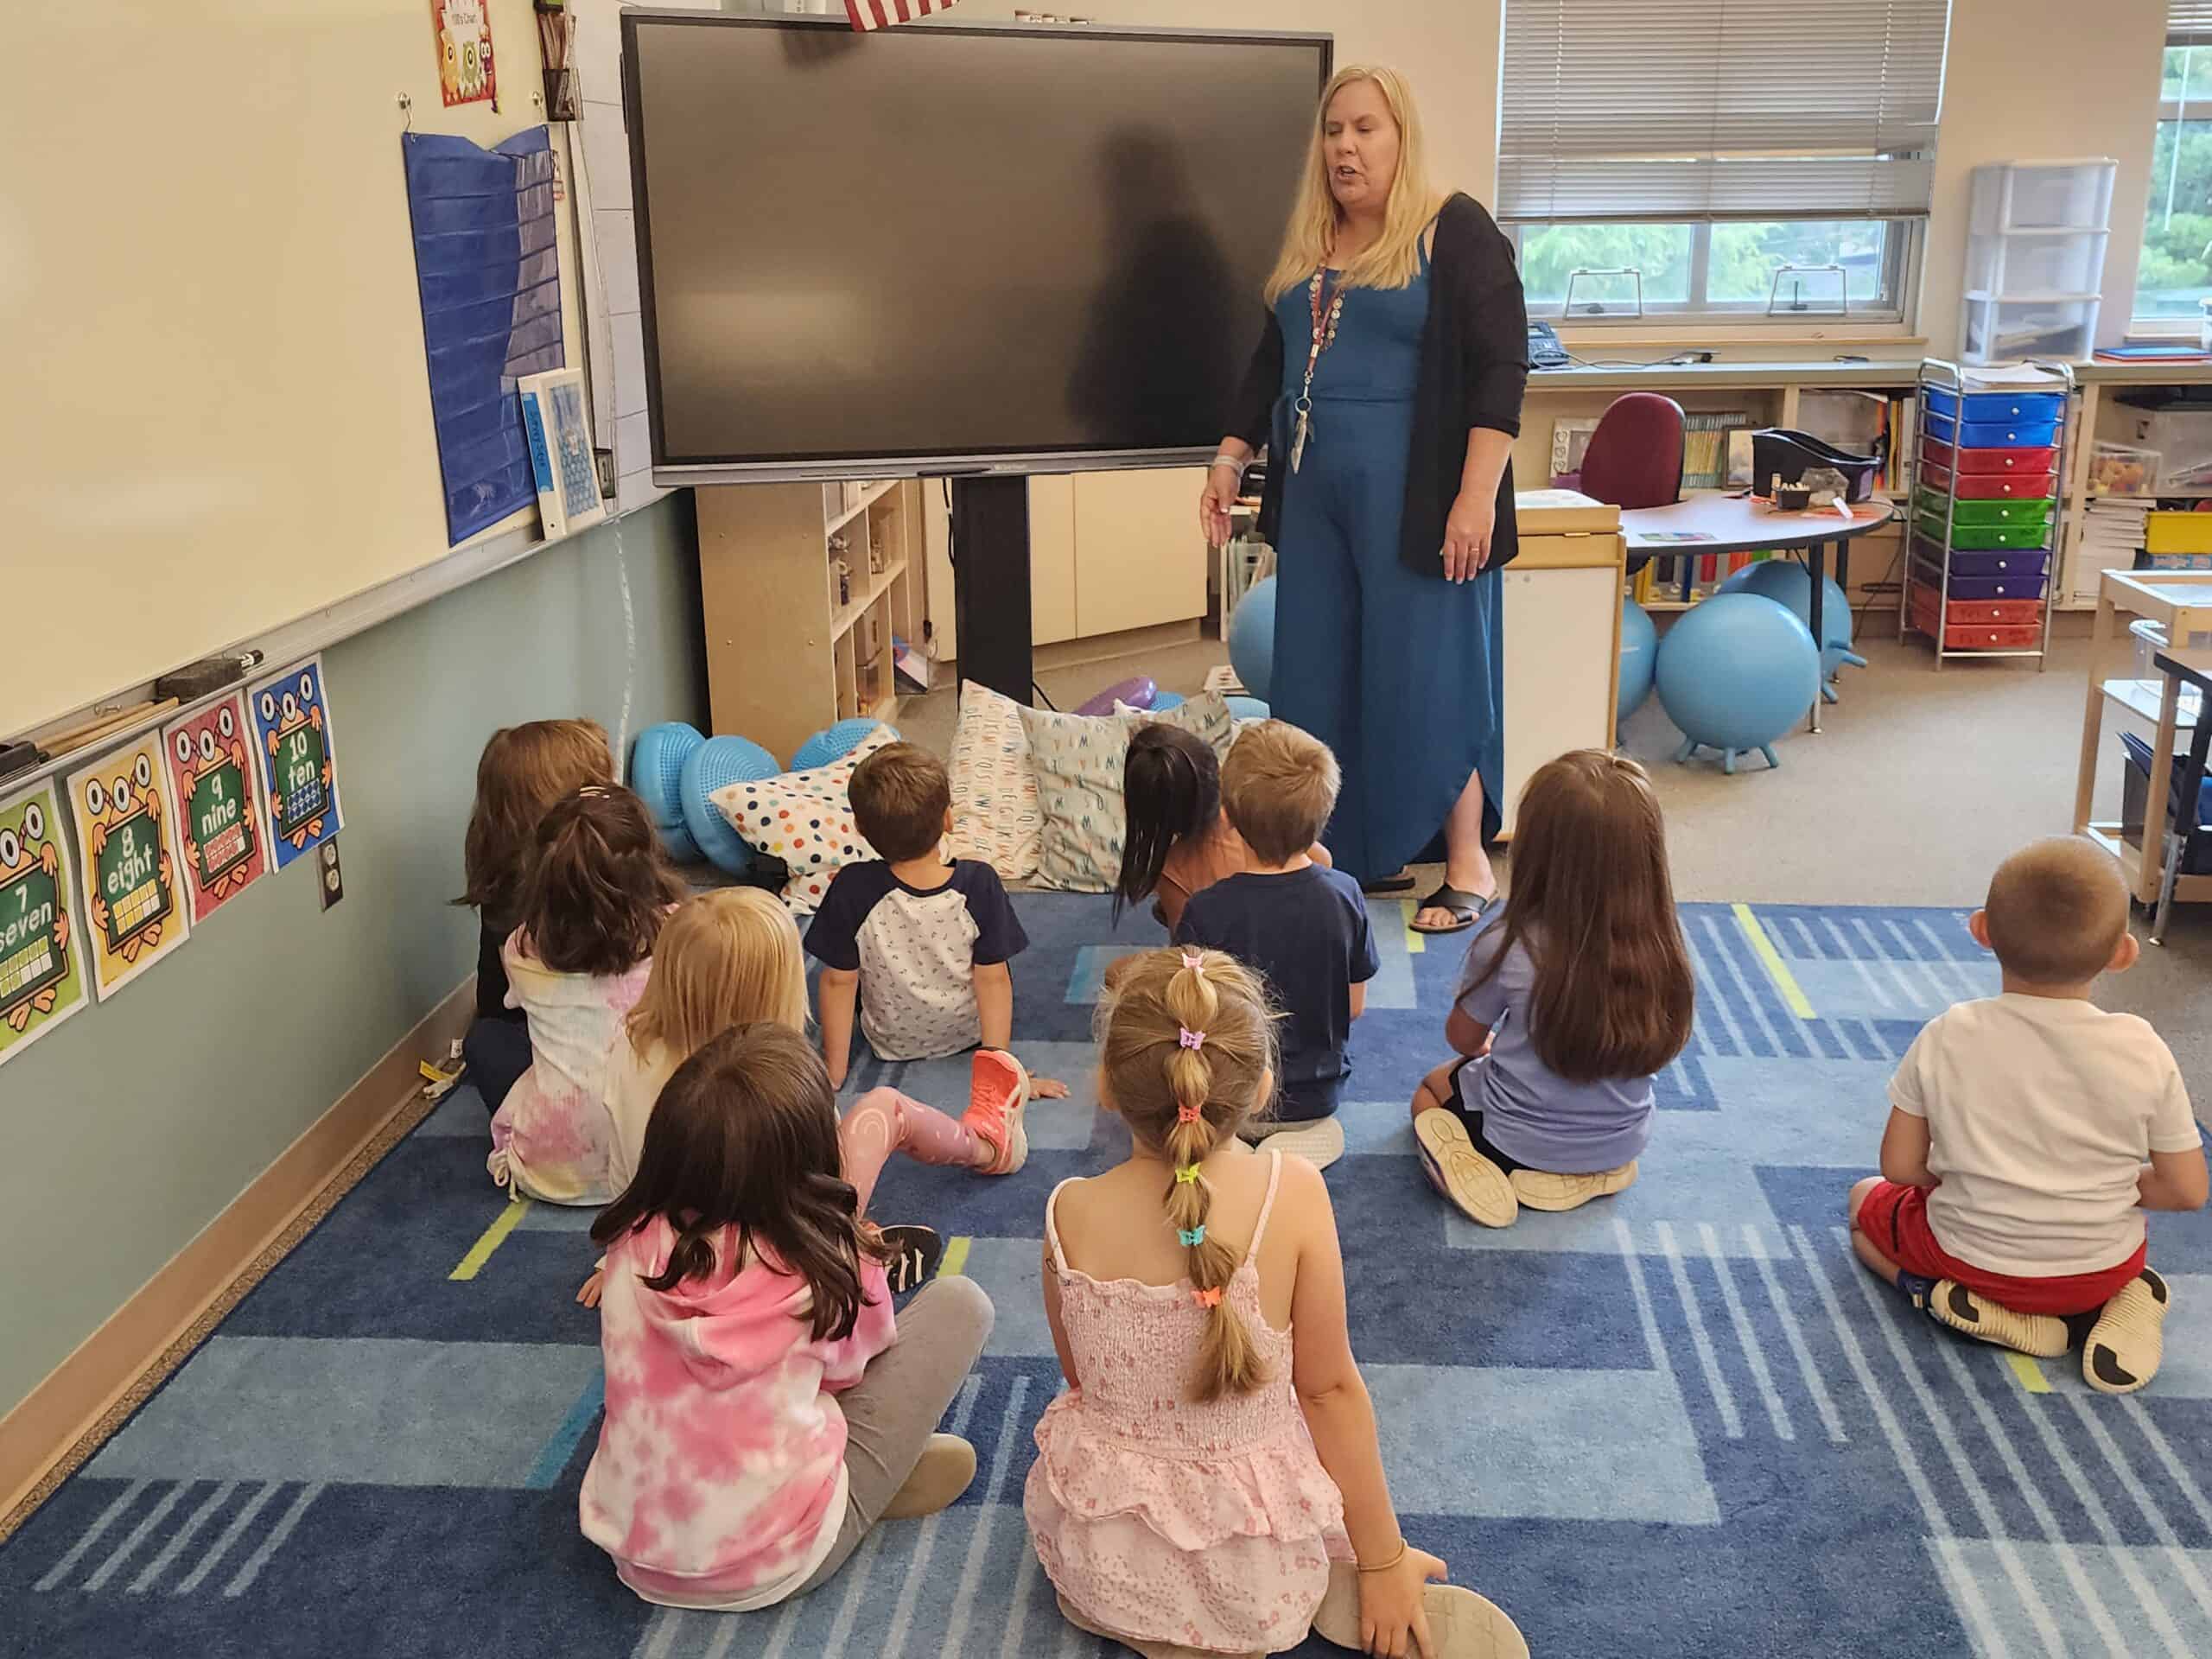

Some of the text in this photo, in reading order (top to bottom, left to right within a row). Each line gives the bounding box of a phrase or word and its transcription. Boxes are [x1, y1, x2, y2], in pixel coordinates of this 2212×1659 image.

[289, 731, 308, 761] 10
[289, 760, 315, 792] ten
[201, 798, 236, 836] nine
[122, 825, 134, 858] 8
[107, 843, 152, 894] eight
[15, 883, 28, 913] 7
